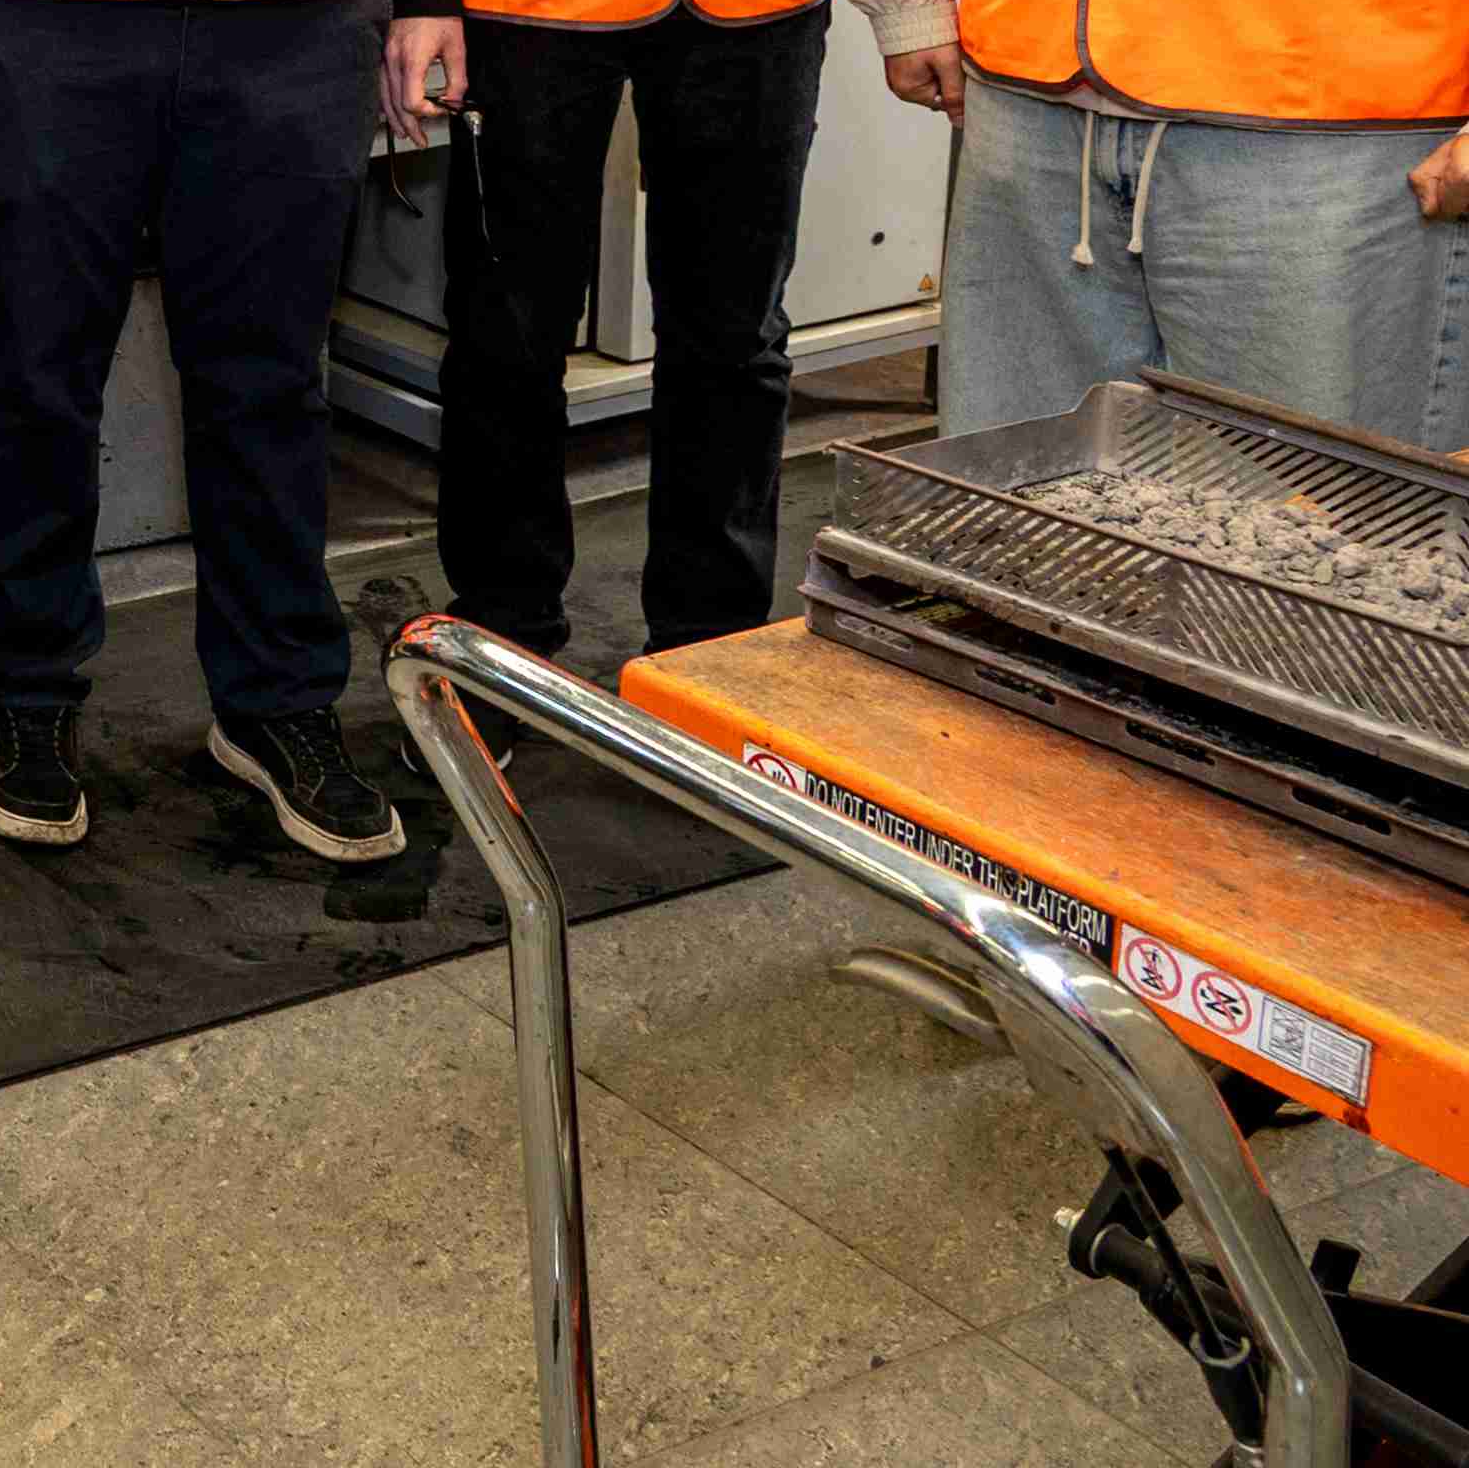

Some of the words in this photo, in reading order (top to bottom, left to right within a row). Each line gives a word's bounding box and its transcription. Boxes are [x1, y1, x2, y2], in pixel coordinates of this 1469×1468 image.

[807, 772, 828, 805] DO
[831, 785, 864, 821] NOT
[865, 802, 915, 850] ENTER
[920, 828, 973, 879] UNDER
[978, 855, 1013, 899] THIS
[1017, 876, 1107, 946] PLATFORM
